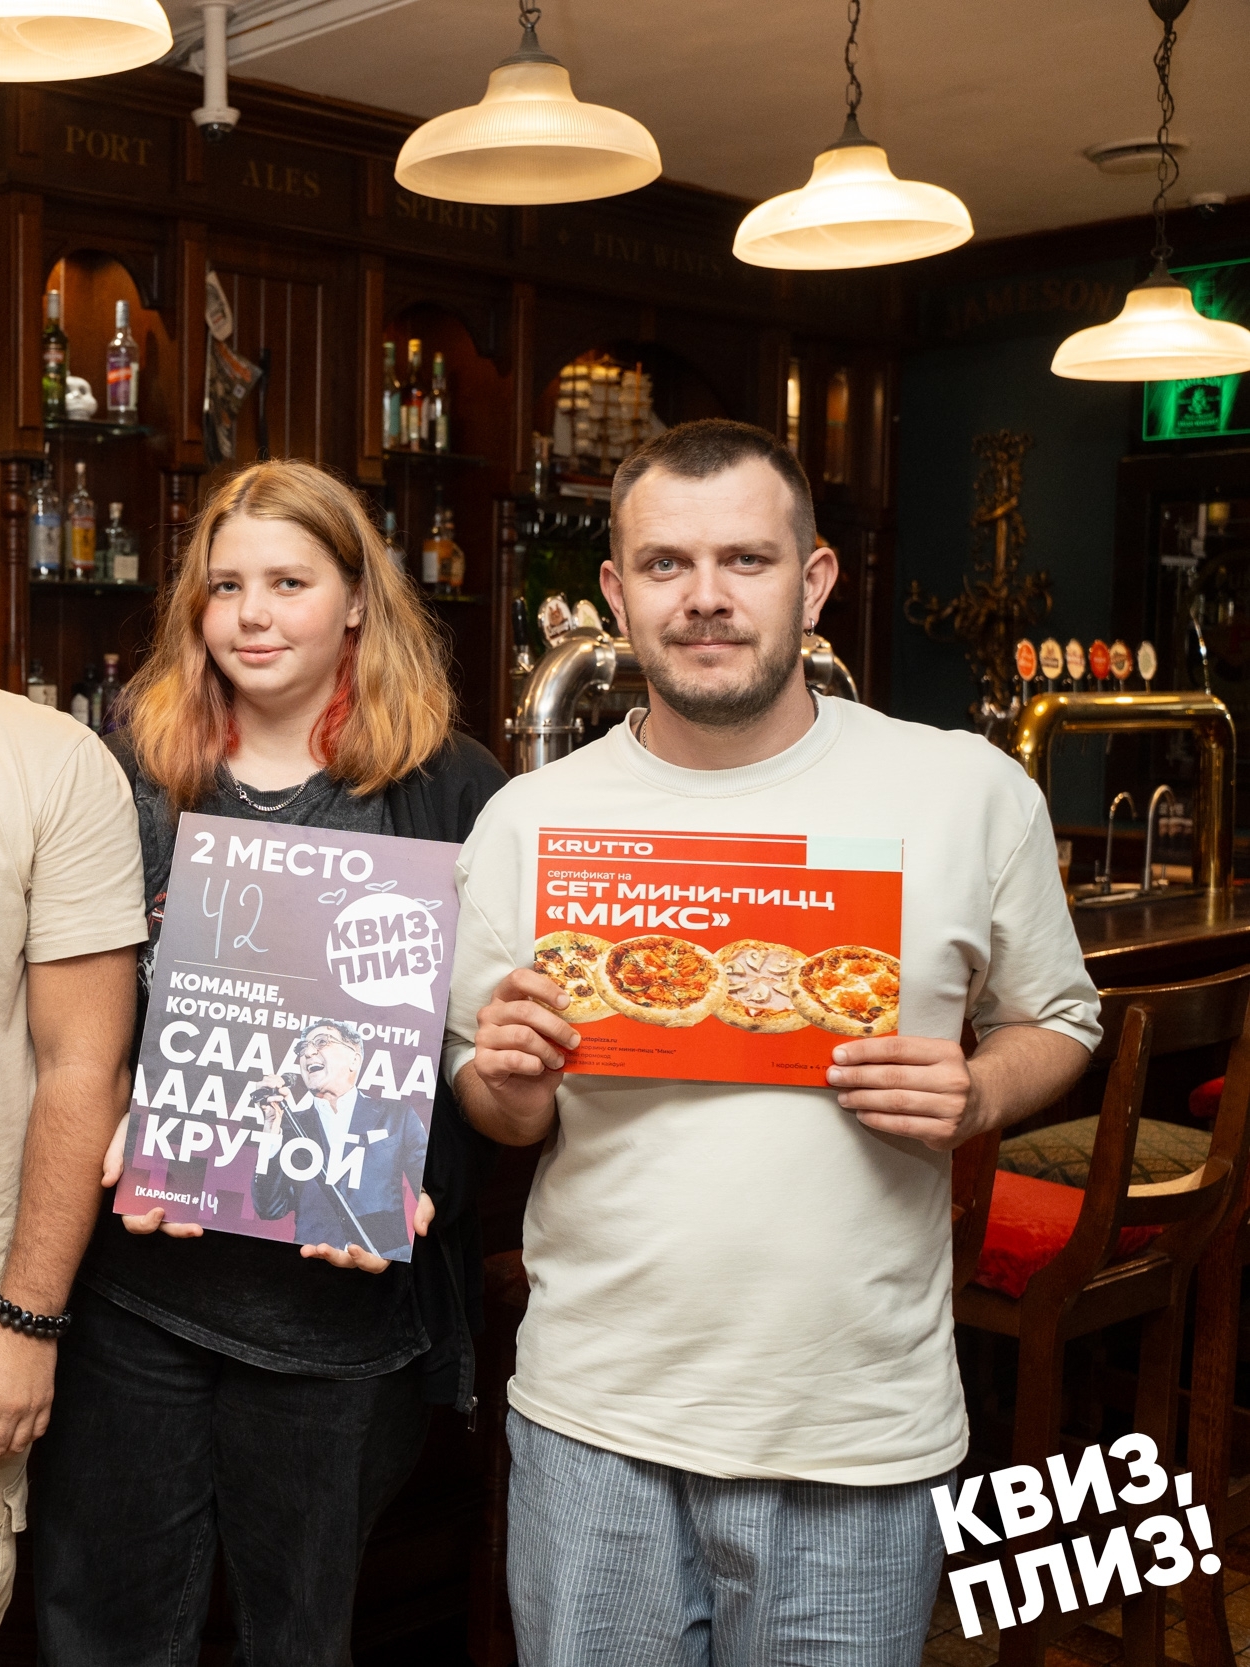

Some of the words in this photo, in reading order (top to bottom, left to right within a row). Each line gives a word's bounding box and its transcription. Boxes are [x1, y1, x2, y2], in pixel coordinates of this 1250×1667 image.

[65, 125, 150, 166] PORT
[242, 159, 321, 198] ALES
[395, 193, 498, 236] SPIRITS
[190, 831, 216, 864] 2
[226, 835, 374, 883] МЕСТО
[547, 839, 654, 856] KRUTTO
[547, 869, 615, 881] сертификат
[617, 872, 632, 881] на
[546, 880, 610, 898] СЕТ
[617, 883, 836, 911] МИНИ-ПИЦЦ
[202, 877, 269, 958] 42
[546, 901, 731, 930] «МИКС»
[170, 971, 285, 1006] КОМАНДЕ,
[165, 995, 269, 1026] КОТОРАЯ
[776, 1062, 808, 1070] коробка
[142, 1113, 366, 1190] КРУТОЙ
[135, 1185, 191, 1205] [КАРАОКЕ]
